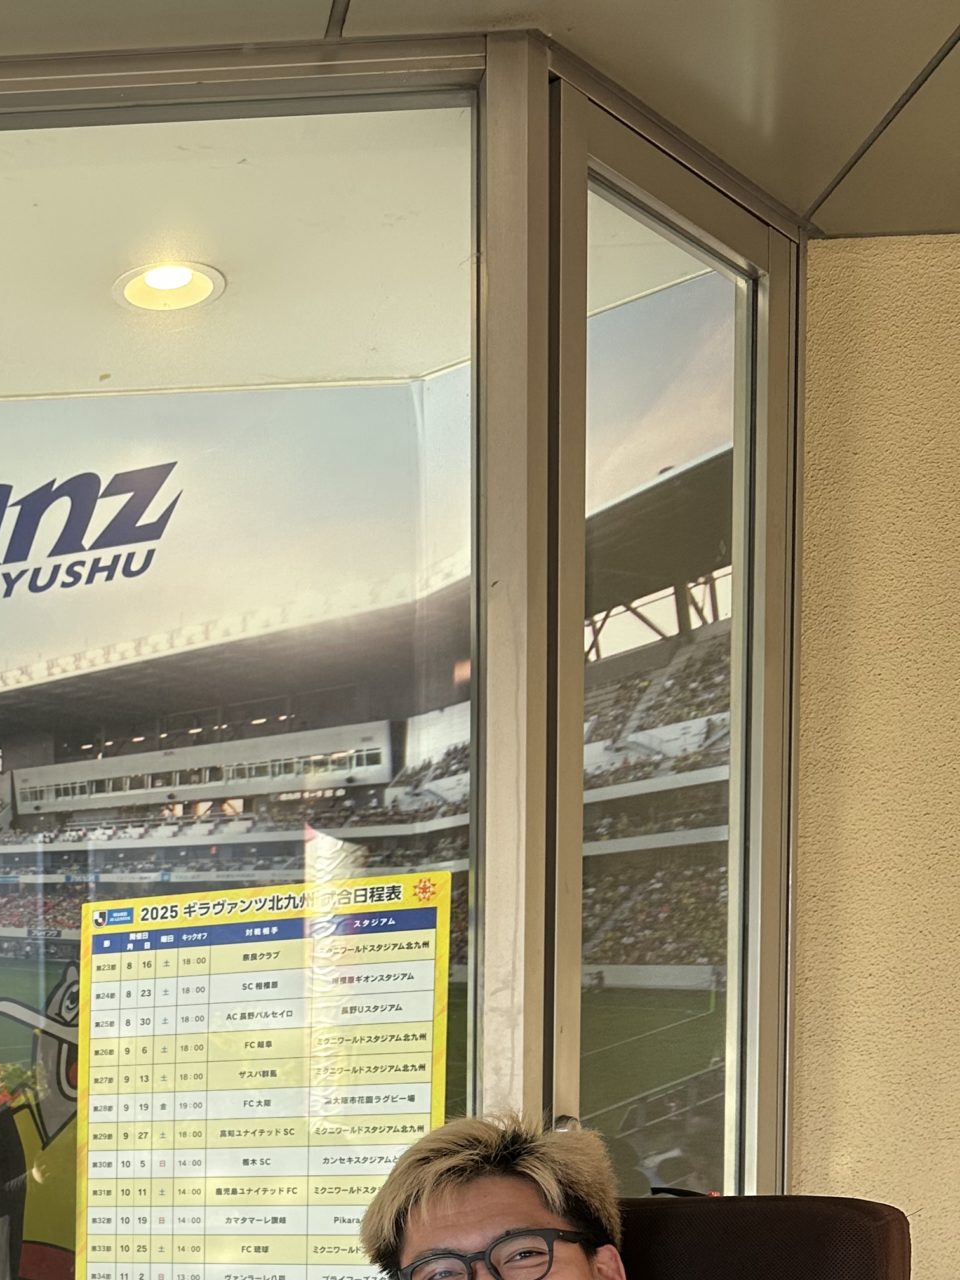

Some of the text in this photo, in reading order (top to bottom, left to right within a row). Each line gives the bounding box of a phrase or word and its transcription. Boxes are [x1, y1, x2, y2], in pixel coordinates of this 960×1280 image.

[140, 905, 178, 922] 2025
[181, 932, 208, 941] キックオフ
[353, 917, 396, 928] スタジアム
[126, 962, 132, 970] 8
[142, 960, 152, 969] 16
[182, 956, 206, 965] 18:00
[125, 990, 131, 998] 8
[140, 988, 151, 997] 23
[181, 985, 205, 994] 18:00
[242, 982, 254, 991] SC
[125, 1018, 131, 1027] 8
[140, 1017, 151, 1026] 30
[181, 1014, 205, 1023] 18:00
[225, 1012, 237, 1021] AC
[124, 1047, 130, 1055] 9
[141, 1046, 147, 1054] 6
[180, 1043, 204, 1052] 18:00
[244, 1040, 255, 1049] FC
[123, 1075, 130, 1083] 9
[139, 1074, 149, 1083] 13
[179, 1072, 203, 1080] 18:00
[123, 1103, 129, 1112] 9
[139, 1103, 149, 1111] 19
[179, 1101, 203, 1109] 19:00
[243, 1099, 254, 1107] FC
[123, 1132, 129, 1140] 9
[137, 1131, 148, 1139] 27
[178, 1130, 202, 1138] 18:00
[283, 1127, 295, 1135] SC
[314, 1123, 425, 1135] ミクニワールドスタジアム北九州
[121, 1160, 131, 1168] 10
[139, 1160, 146, 1168] 5
[260, 1157, 271, 1165] SC
[120, 1188, 130, 1196] 10
[138, 1188, 146, 1196] 11
[286, 1186, 297, 1194] FC
[313, 1185, 382, 1194] ミクニワールドスタ
[120, 1216, 130, 1224] 10
[137, 1216, 147, 1224] 19
[177, 1216, 201, 1224] 14:00
[119, 1244, 130, 1252] 10
[136, 1244, 147, 1252] 25
[241, 1245, 252, 1253] FC
[120, 1272, 128, 1280] 11
[176, 1273, 200, 1280] 13:00
